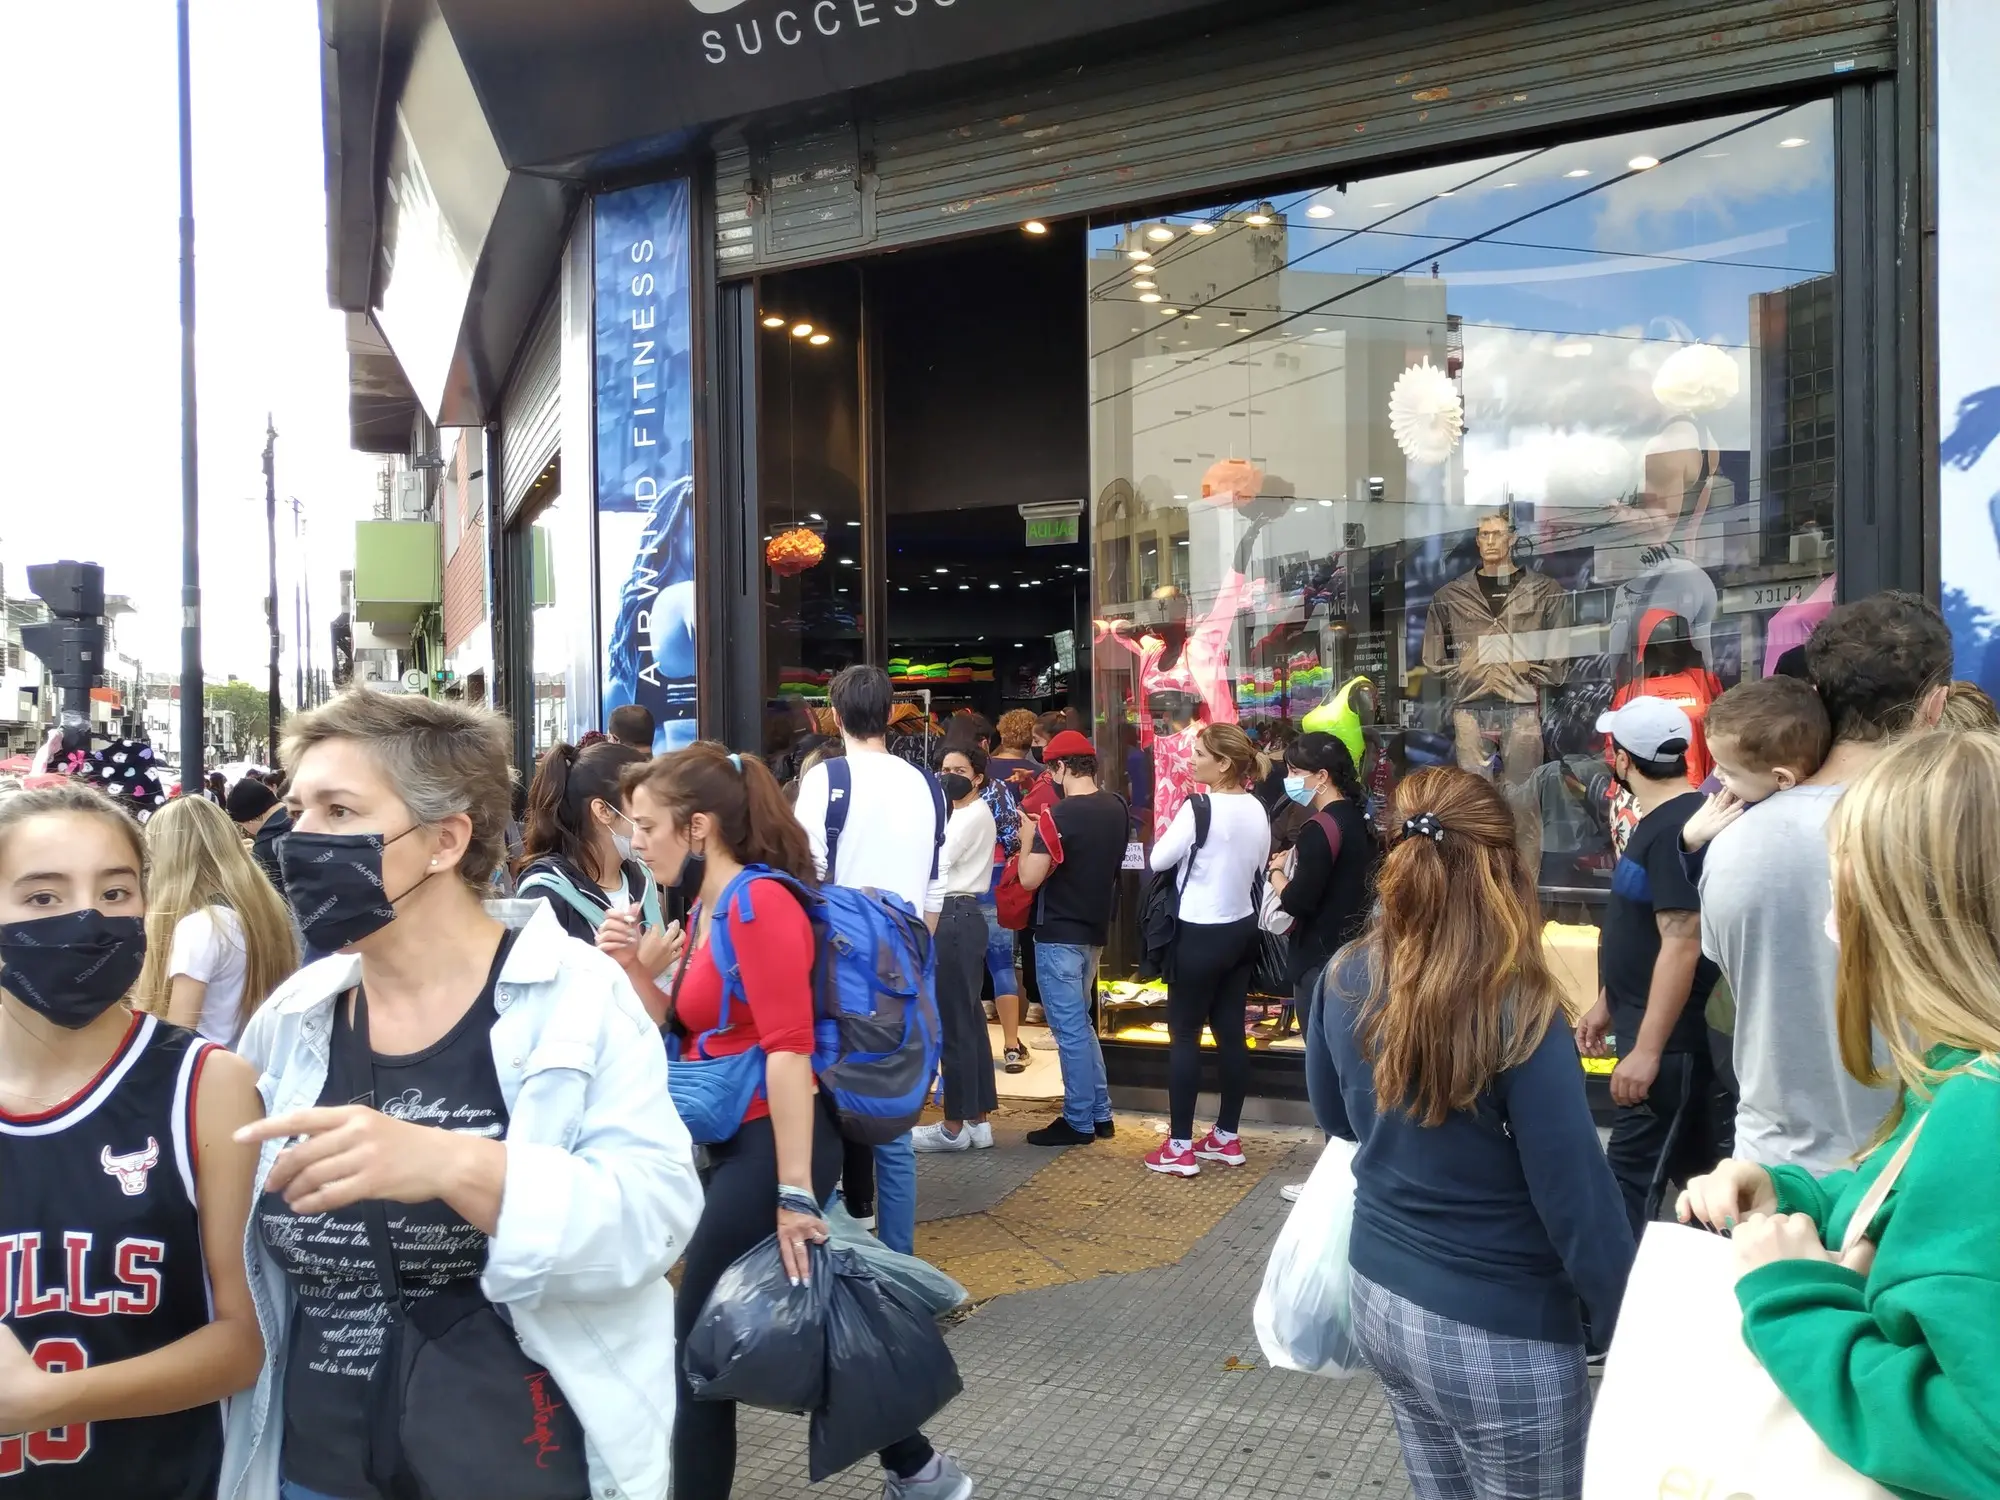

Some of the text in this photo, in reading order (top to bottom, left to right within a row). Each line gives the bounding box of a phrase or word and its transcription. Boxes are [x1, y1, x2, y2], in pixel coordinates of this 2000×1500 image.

[702, 0, 956, 63] SUCCES
[631, 238, 661, 687] AIRWIND FITNESS
[452, 1104, 496, 1123] deeper.
[307, 1230, 349, 1245] almost
